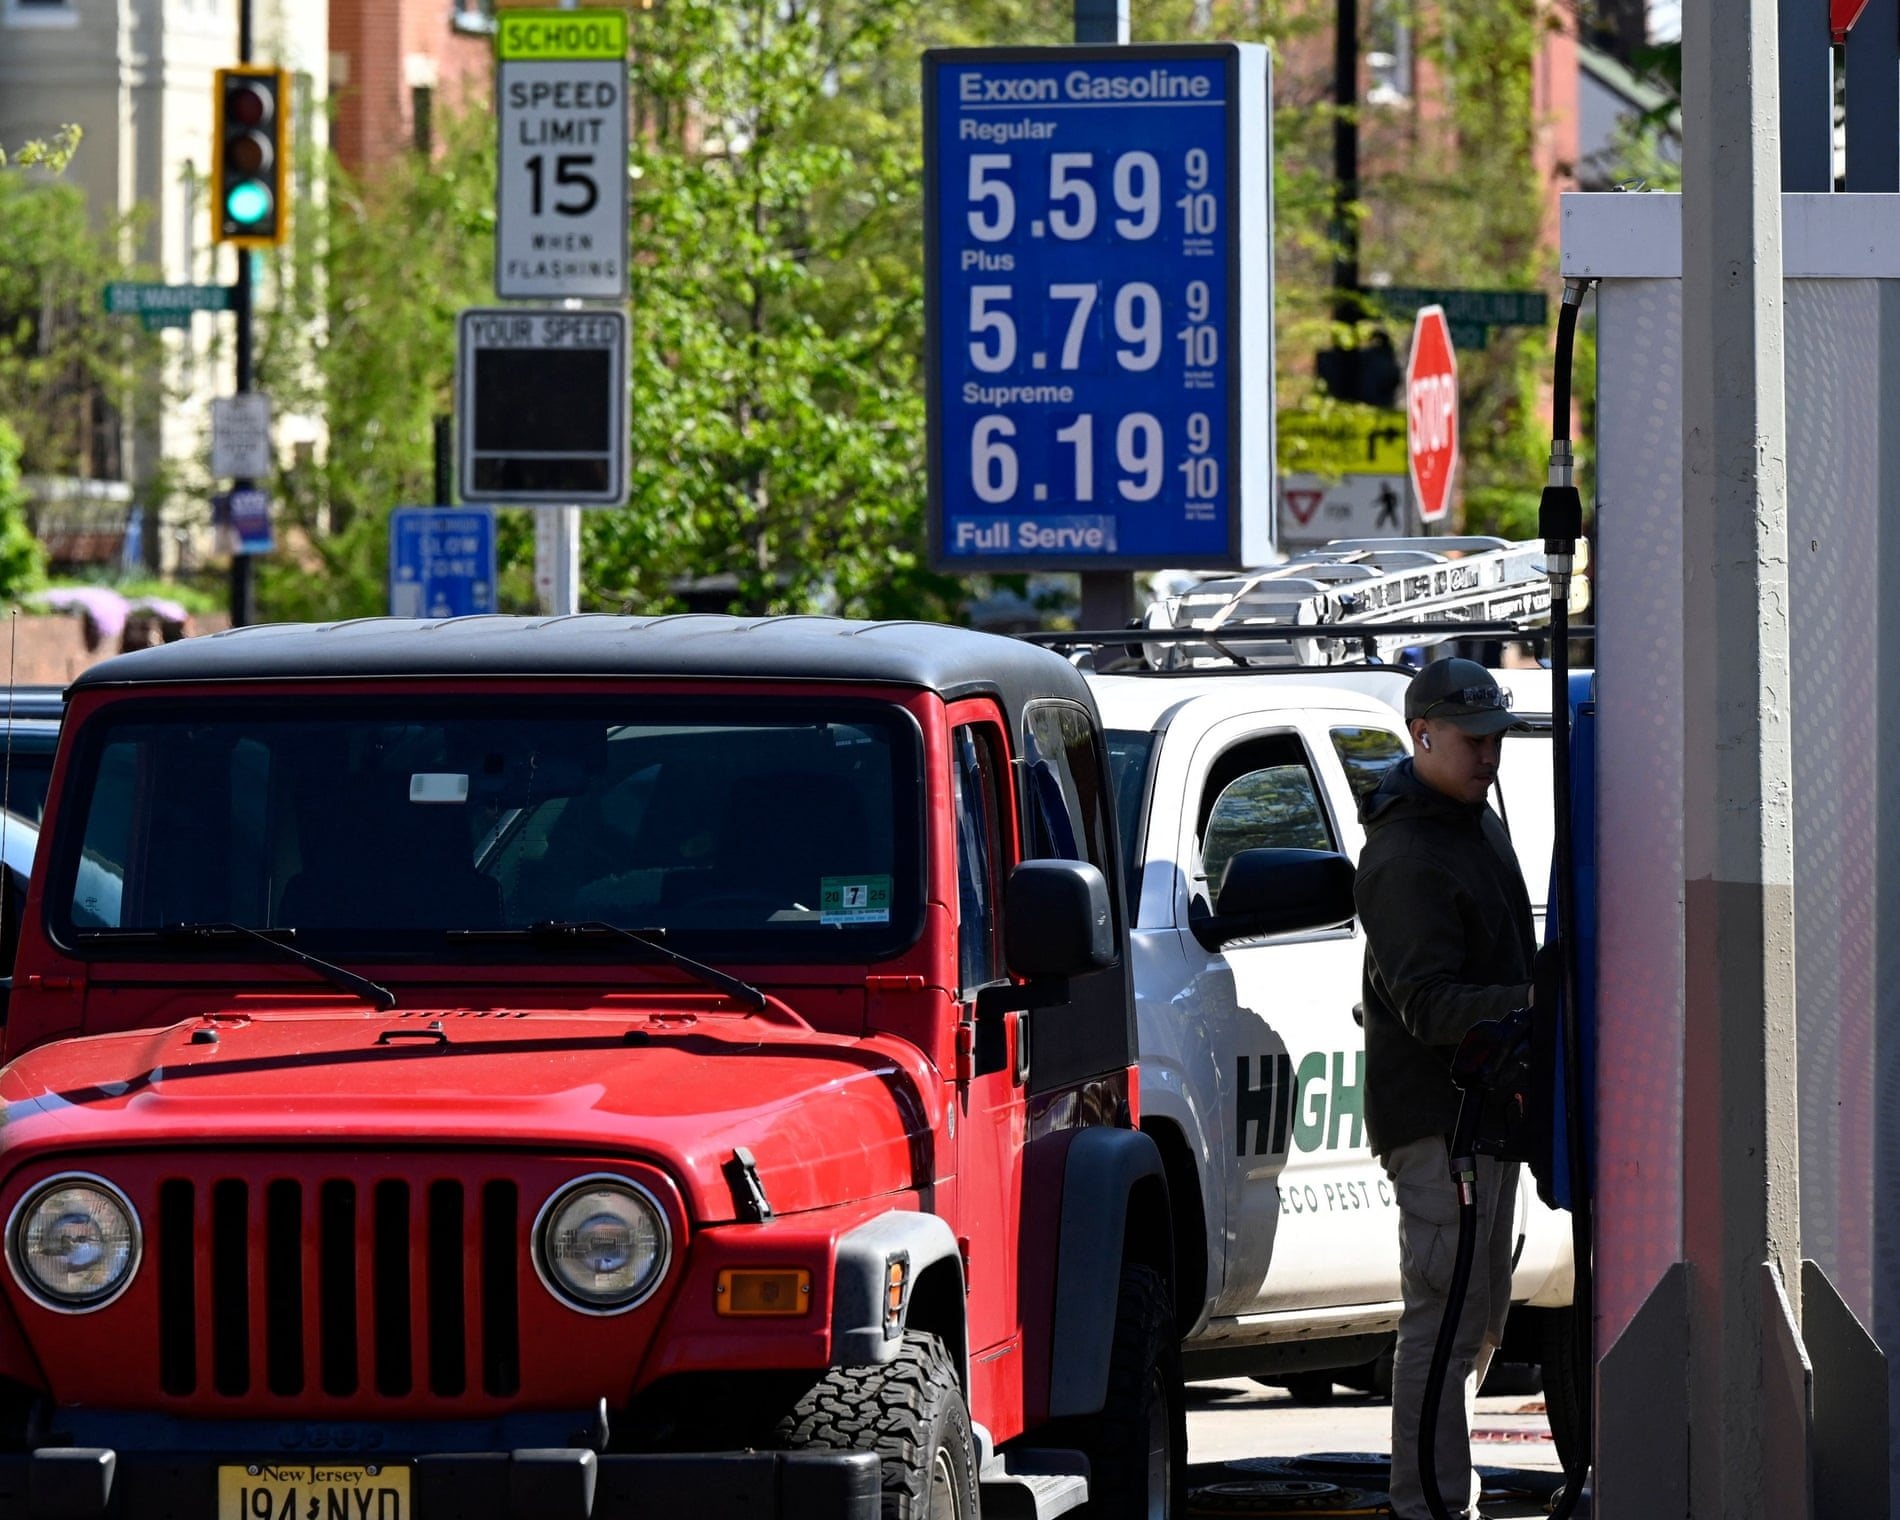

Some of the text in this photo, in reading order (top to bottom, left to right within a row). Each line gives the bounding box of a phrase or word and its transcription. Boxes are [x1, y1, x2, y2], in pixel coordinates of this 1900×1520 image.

[508, 24, 617, 51] SCHOOL
[510, 82, 617, 109] SPEED
[960, 69, 1210, 101] Exxon Gasoline
[519, 118, 604, 146] LIMIT
[959, 118, 1056, 144] Regular
[525, 155, 598, 217] 15
[967, 151, 1160, 241] 5.59
[532, 233, 593, 251] WHEN
[507, 260, 616, 279] FLASHING
[961, 250, 1015, 271] Plus
[471, 319, 617, 344] YOUR SPEED
[969, 281, 1162, 372] 5.79
[963, 382, 1073, 408] Supreme
[1411, 373, 1455, 455] STOP
[971, 413, 1163, 502] 6.19
[957, 521, 1104, 548] Full Serve
[825, 887, 886, 904] 20 7 25
[1237, 1051, 1372, 1157] HIGH
[1277, 1185, 1318, 1214] ECO
[1323, 1181, 1370, 1211] PEST
[262, 1466, 363, 1485] New Jersey
